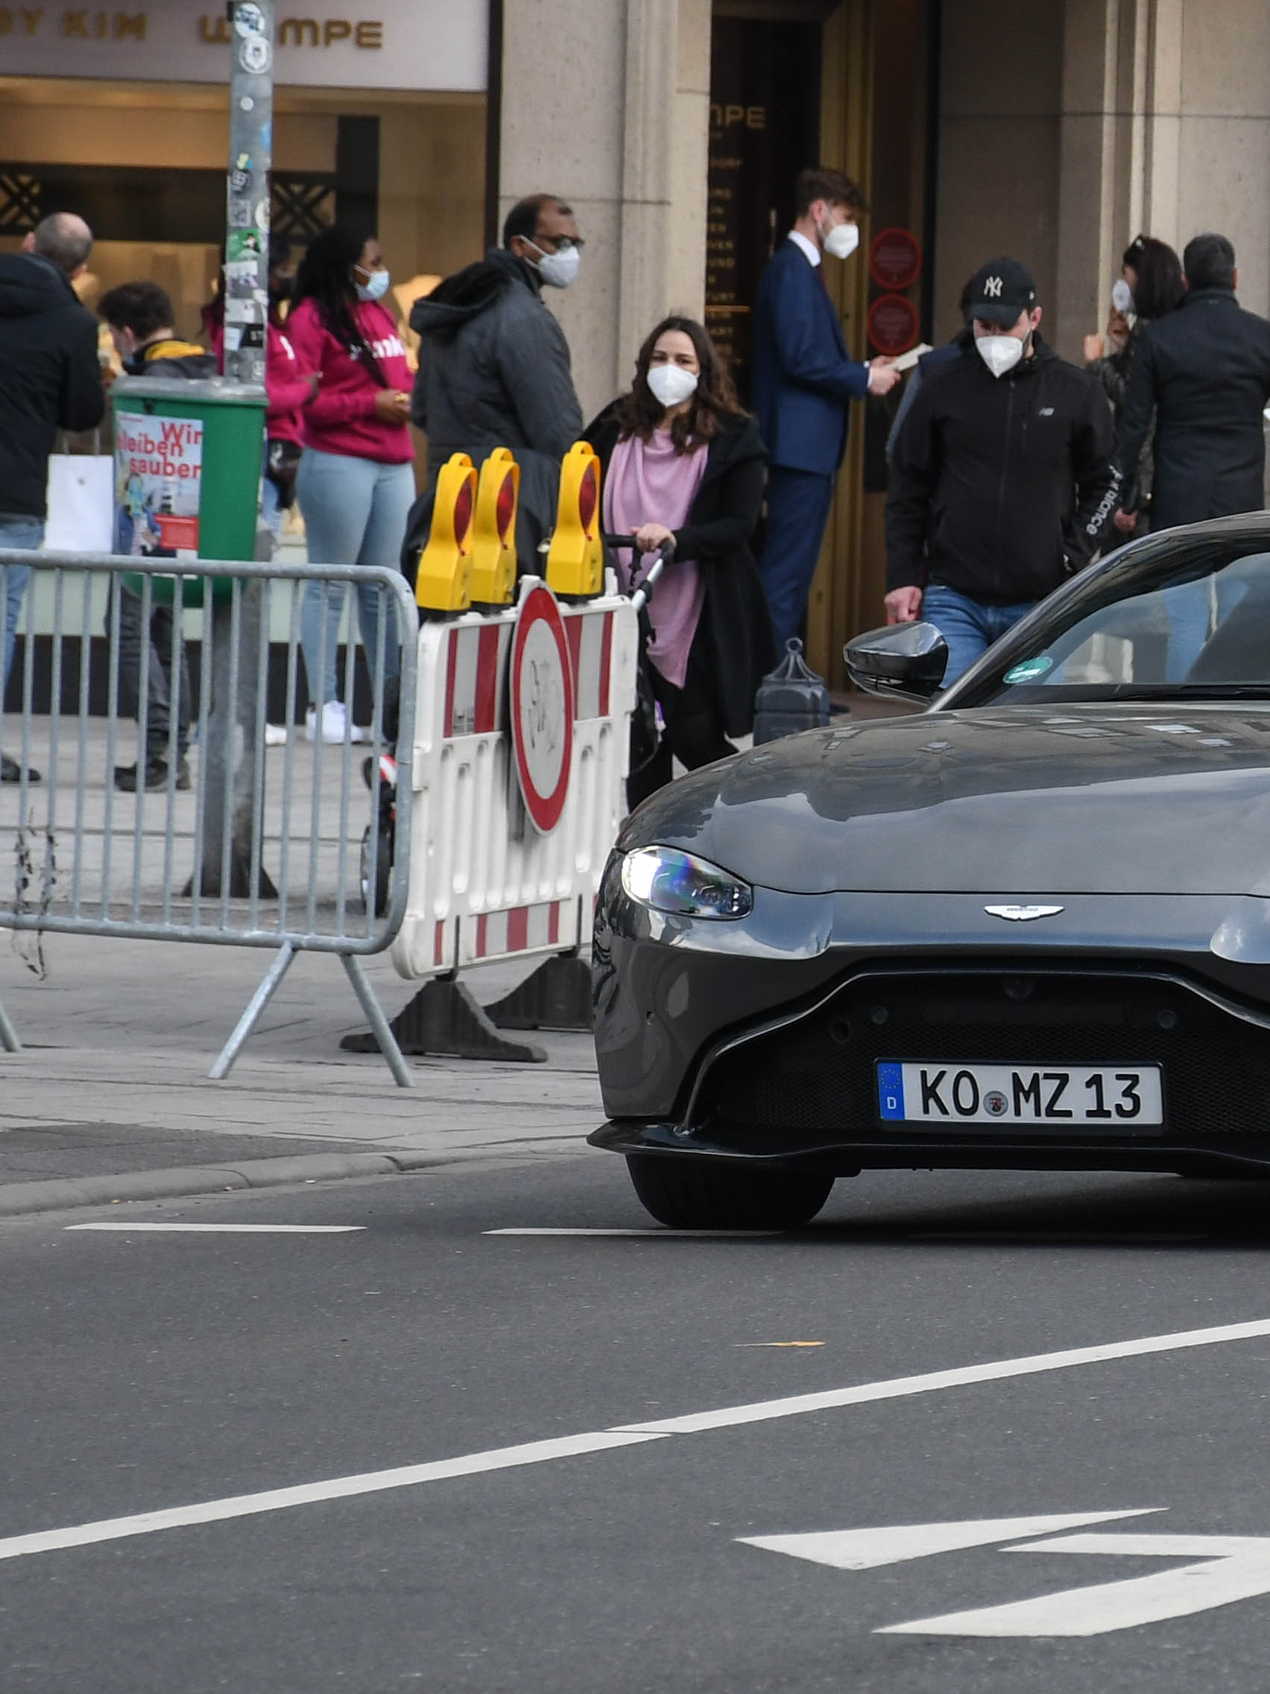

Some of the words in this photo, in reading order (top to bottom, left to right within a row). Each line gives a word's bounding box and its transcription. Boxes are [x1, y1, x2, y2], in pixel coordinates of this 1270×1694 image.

[64, 9, 147, 41] KIM
[200, 15, 383, 49] WMPE
[160, 421, 203, 446] Wir
[129, 454, 203, 479] sauber
[886, 1096, 897, 1110] D
[920, 1069, 980, 1116] KO
[1012, 1071, 1073, 1117] MZ
[1085, 1073, 1141, 1119] 13
